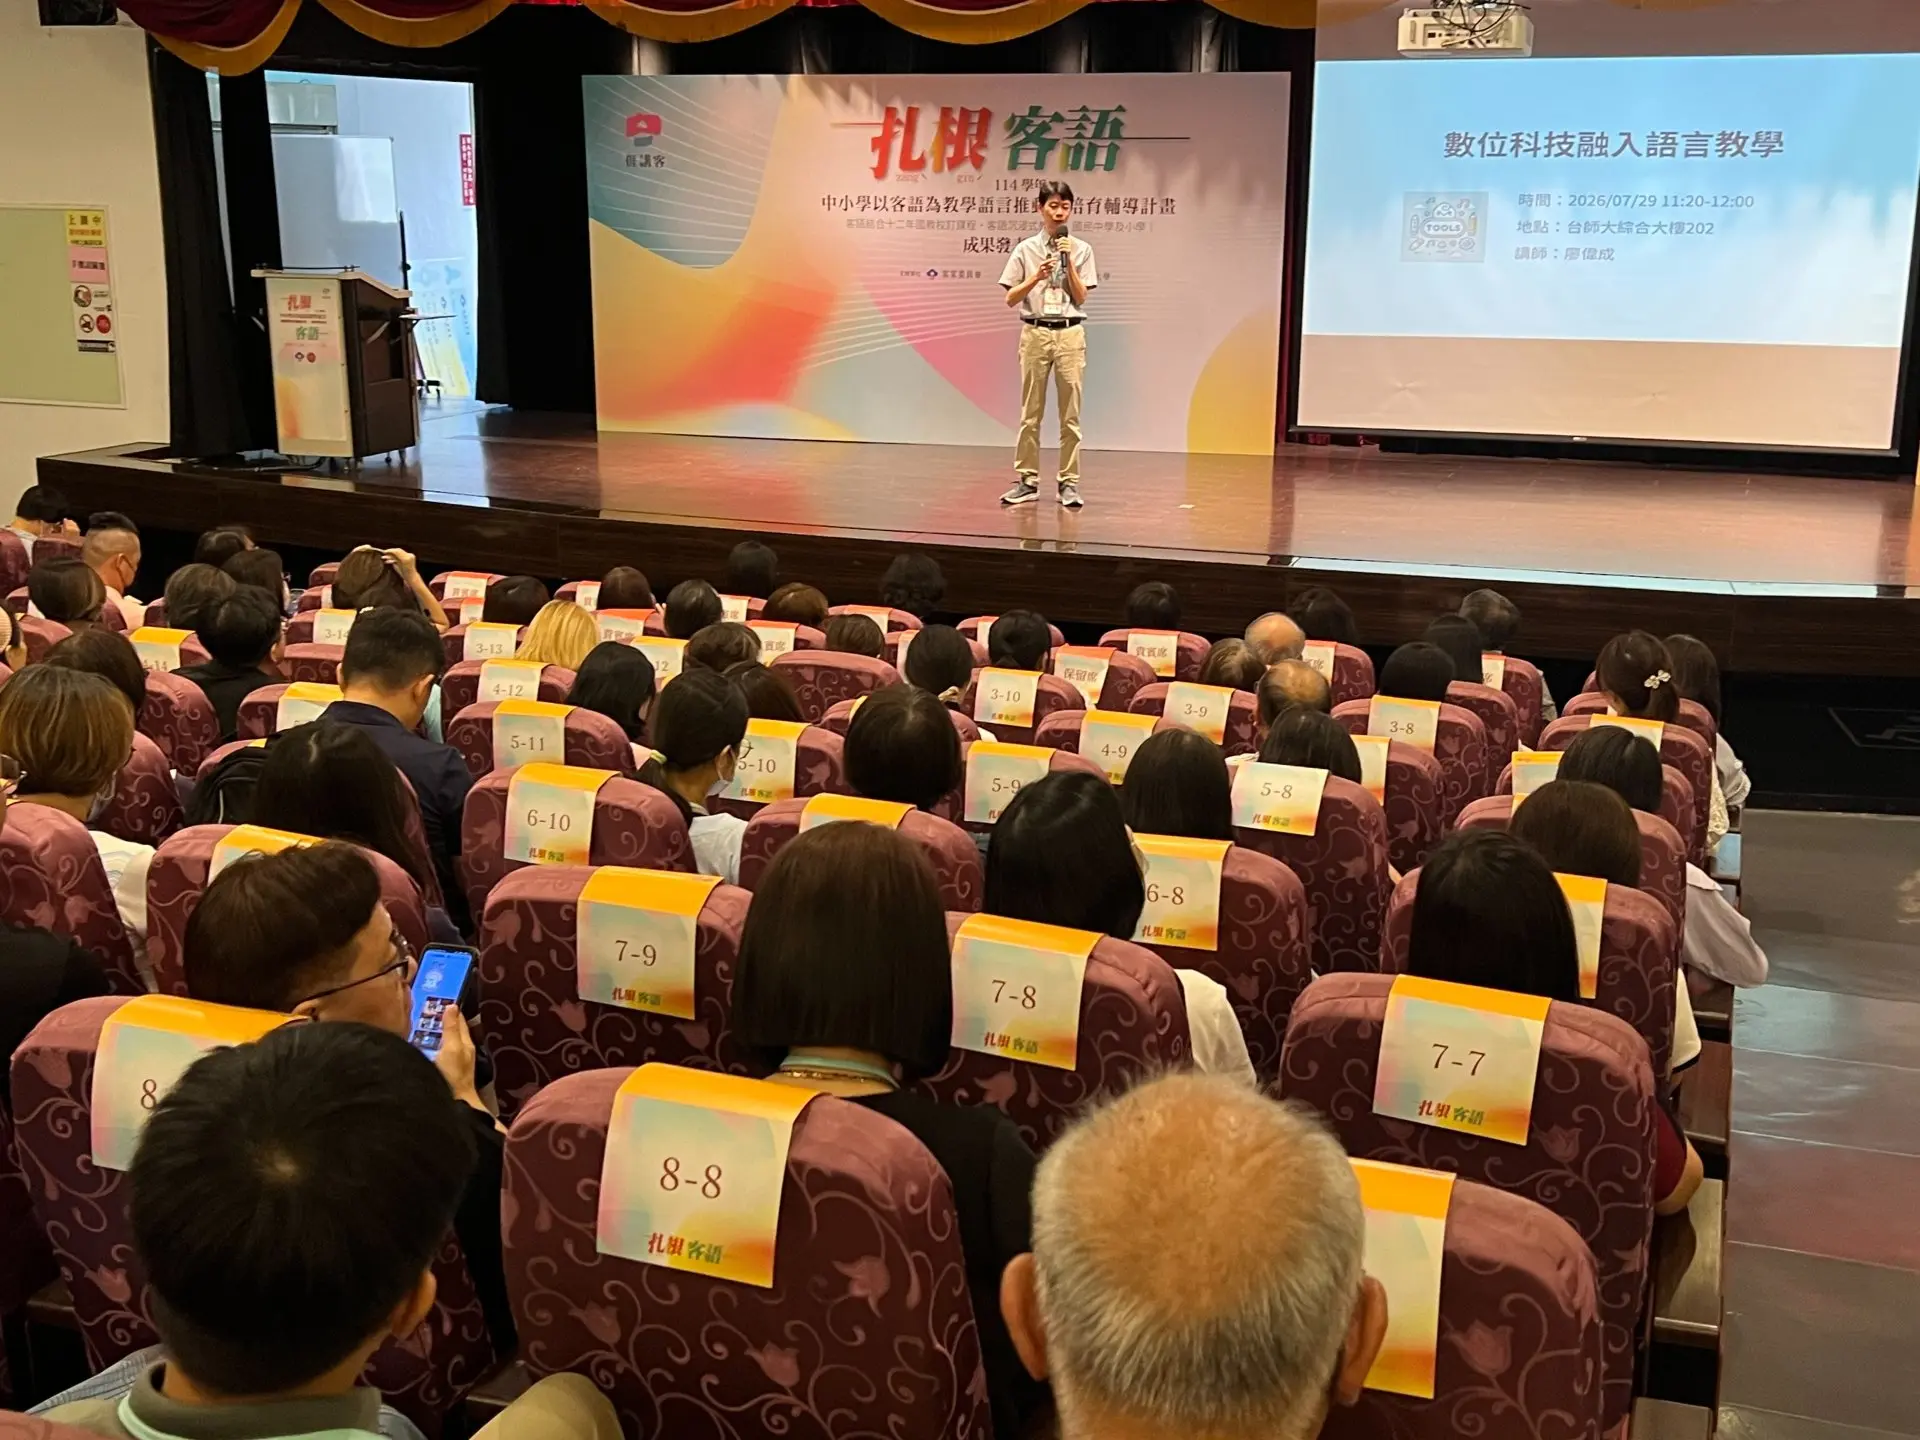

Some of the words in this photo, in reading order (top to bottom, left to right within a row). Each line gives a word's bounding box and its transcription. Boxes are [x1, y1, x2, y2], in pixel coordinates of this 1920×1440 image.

[1443, 131, 1785, 159] 數位科技融入語言教學
[996, 179, 1017, 191] 114
[1021, 178, 1048, 192] 學年
[1661, 194, 1755, 208] 11:20-12:00
[1425, 223, 1462, 232] TOOLS
[963, 236, 1025, 254] 成果發
[475, 643, 504, 655] 3-13
[1063, 667, 1098, 683] 保留席
[492, 683, 525, 697] 4-12
[990, 688, 1021, 702] 3-10
[1184, 703, 1208, 718] 3-9
[1389, 720, 1415, 734] 3-8
[510, 735, 545, 752] 5-11
[1101, 743, 1128, 759] 4-9
[738, 758, 776, 774] 5-10
[991, 777, 1021, 795] 5-9
[1260, 782, 1293, 799] 5-8
[527, 809, 571, 832] 6-10
[1146, 883, 1184, 905] 6-8
[615, 939, 658, 967] 7-9
[991, 979, 1037, 1009] 7-8
[1431, 1043, 1486, 1076] 7-7
[140, 1078, 157, 1110] 8
[659, 1156, 723, 1199] 8-8
